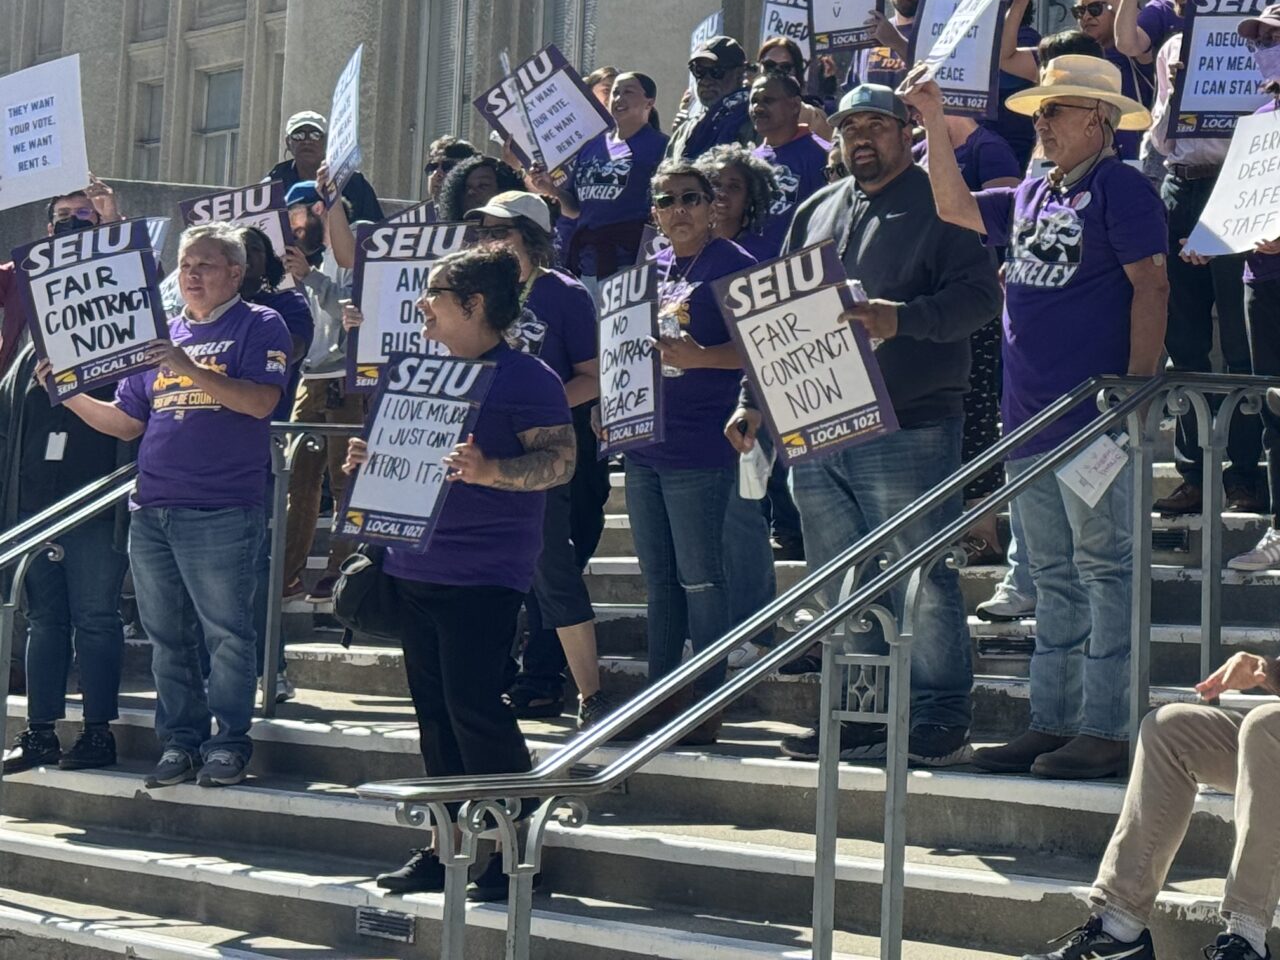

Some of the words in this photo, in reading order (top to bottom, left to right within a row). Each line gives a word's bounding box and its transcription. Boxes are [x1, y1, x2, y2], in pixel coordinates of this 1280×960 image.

[832, 34, 858, 46] LOCAL
[1199, 56, 1224, 71] PAY
[535, 83, 559, 103] WANT
[1193, 80, 1199, 95] I
[1201, 80, 1227, 95] CAN
[8, 104, 29, 118] THEY
[31, 96, 54, 111] WANT
[967, 97, 988, 108] 1021
[9, 122, 30, 136] YOUR
[32, 115, 56, 129] VOTE.
[541, 127, 556, 143] WE
[554, 113, 577, 132] WANT
[13, 140, 26, 154] WE
[29, 135, 52, 150] WANT
[555, 135, 575, 154] RENT
[18, 157, 39, 172] RENT
[194, 185, 271, 226] SEIU
[1221, 210, 1280, 237] STAFF
[29, 222, 131, 277] SEIU
[366, 225, 467, 259] SEIU
[45, 266, 118, 305] FAIR
[600, 264, 650, 317] SEIU
[728, 247, 825, 318] SEIU
[45, 287, 149, 335] CONTRACT
[70, 315, 136, 358] NOW
[611, 315, 629, 338] NO
[748, 312, 812, 359] FAIR
[83, 357, 127, 380] LOCAL
[760, 326, 851, 388] CONTRACT
[57, 379, 78, 396] SEIU
[356, 378, 378, 386] SEIU
[387, 357, 483, 397] SEIU
[610, 369, 631, 393] NO
[602, 387, 650, 422] PEACE
[784, 367, 843, 419] NOW
[391, 399, 427, 422] LOVE
[389, 428, 426, 446] JUST
[609, 426, 634, 443] LOCAL
[635, 421, 654, 435] 1021
[810, 421, 851, 446] LOCAL
[852, 410, 881, 429] 1021
[786, 444, 808, 460] SEIU
[364, 452, 410, 480] AFFORD
[366, 520, 401, 535] LOCAL
[402, 523, 426, 537] 1021
